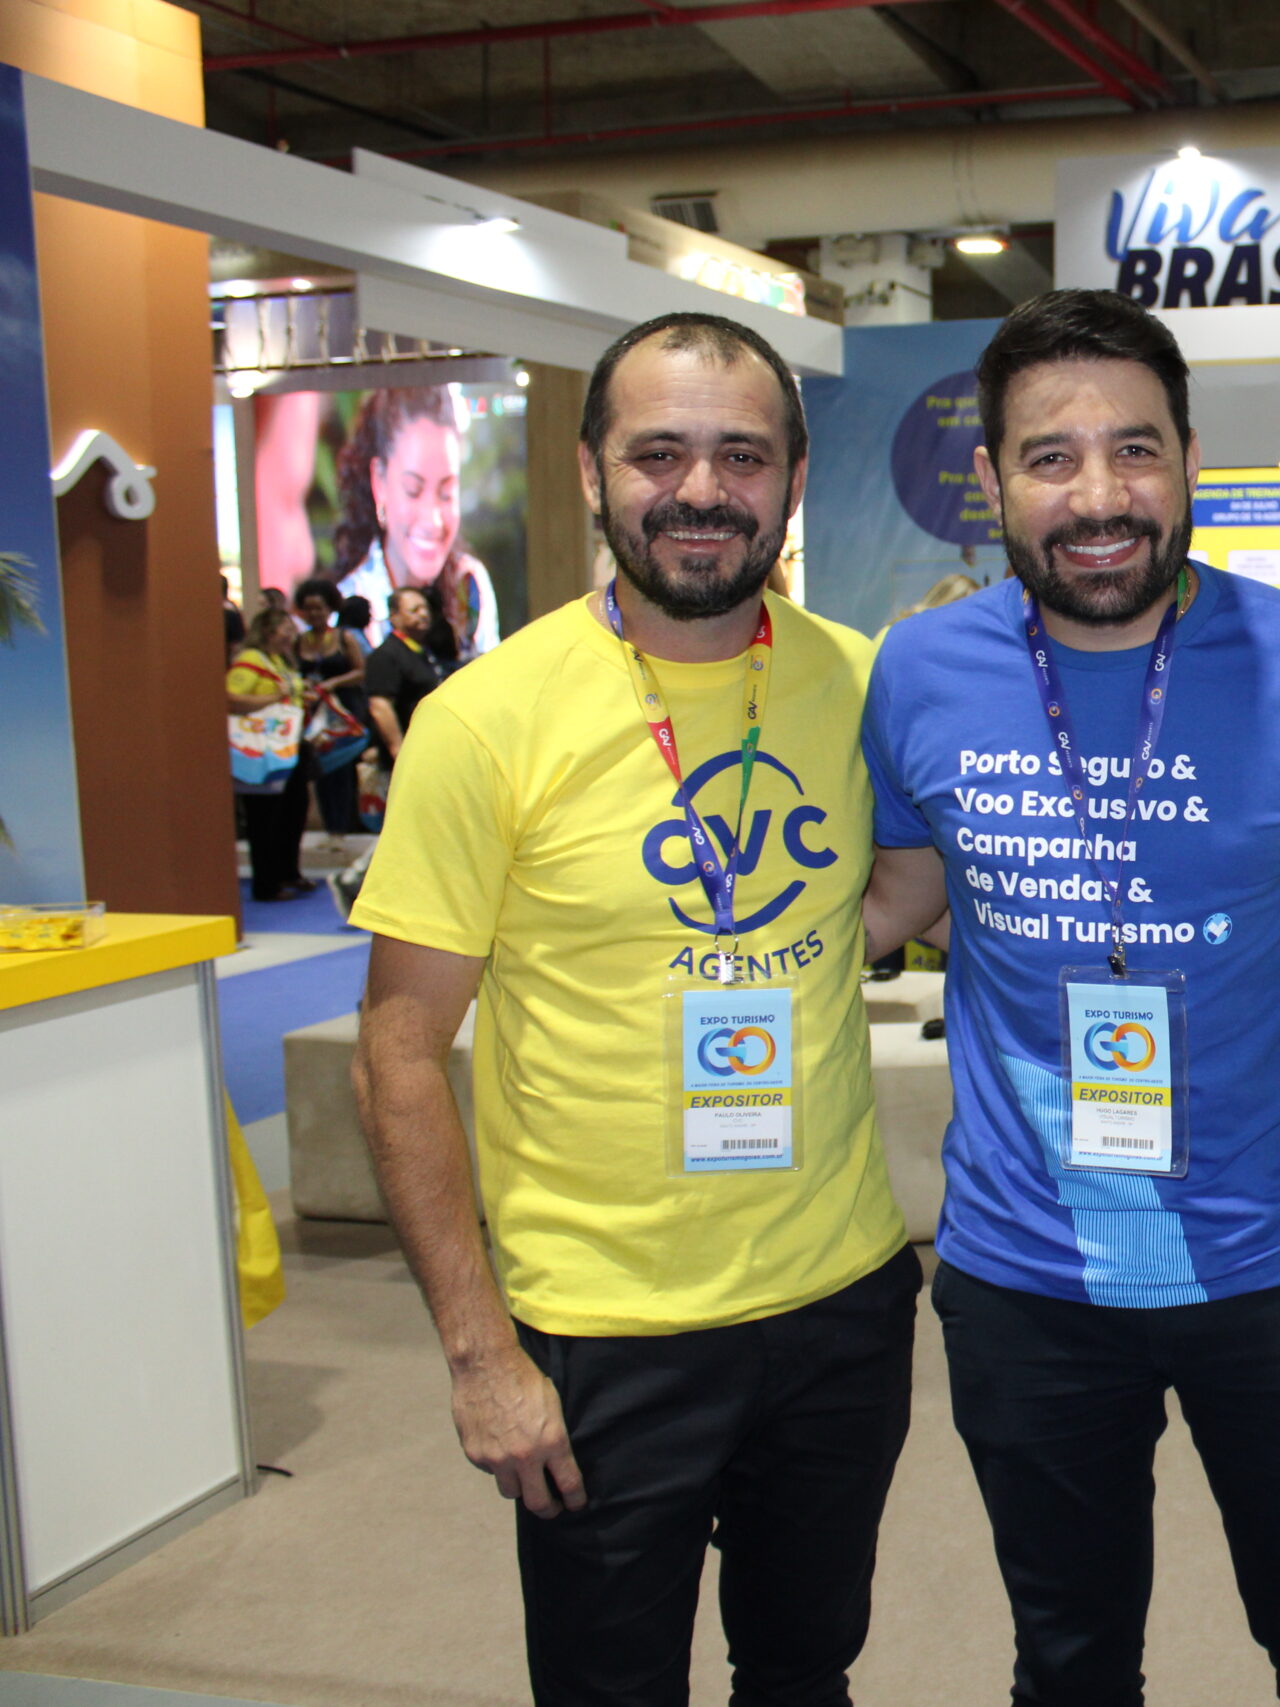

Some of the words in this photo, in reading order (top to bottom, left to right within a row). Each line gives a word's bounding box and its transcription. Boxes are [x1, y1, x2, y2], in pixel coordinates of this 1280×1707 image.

[960, 750, 1040, 775] Porto
[1048, 751, 1165, 787] Sguo
[1171, 754, 1197, 780] &
[954, 788, 1014, 816] Voo
[1021, 791, 1177, 822] Excusvo
[1183, 796, 1209, 822] &
[641, 805, 839, 886] CVC
[956, 827, 1136, 866] Campanha
[965, 865, 994, 892] de
[1127, 877, 1154, 903] &
[974, 898, 1049, 941] Visual
[700, 1016, 729, 1026] EXPO
[731, 1014, 775, 1025] TURISMO
[1085, 1009, 1110, 1019] EXPO
[1112, 1010, 1154, 1020] TURISMO
[691, 1093, 784, 1109] EXPOSITOR
[1079, 1088, 1164, 1105] EXPOSITOR
